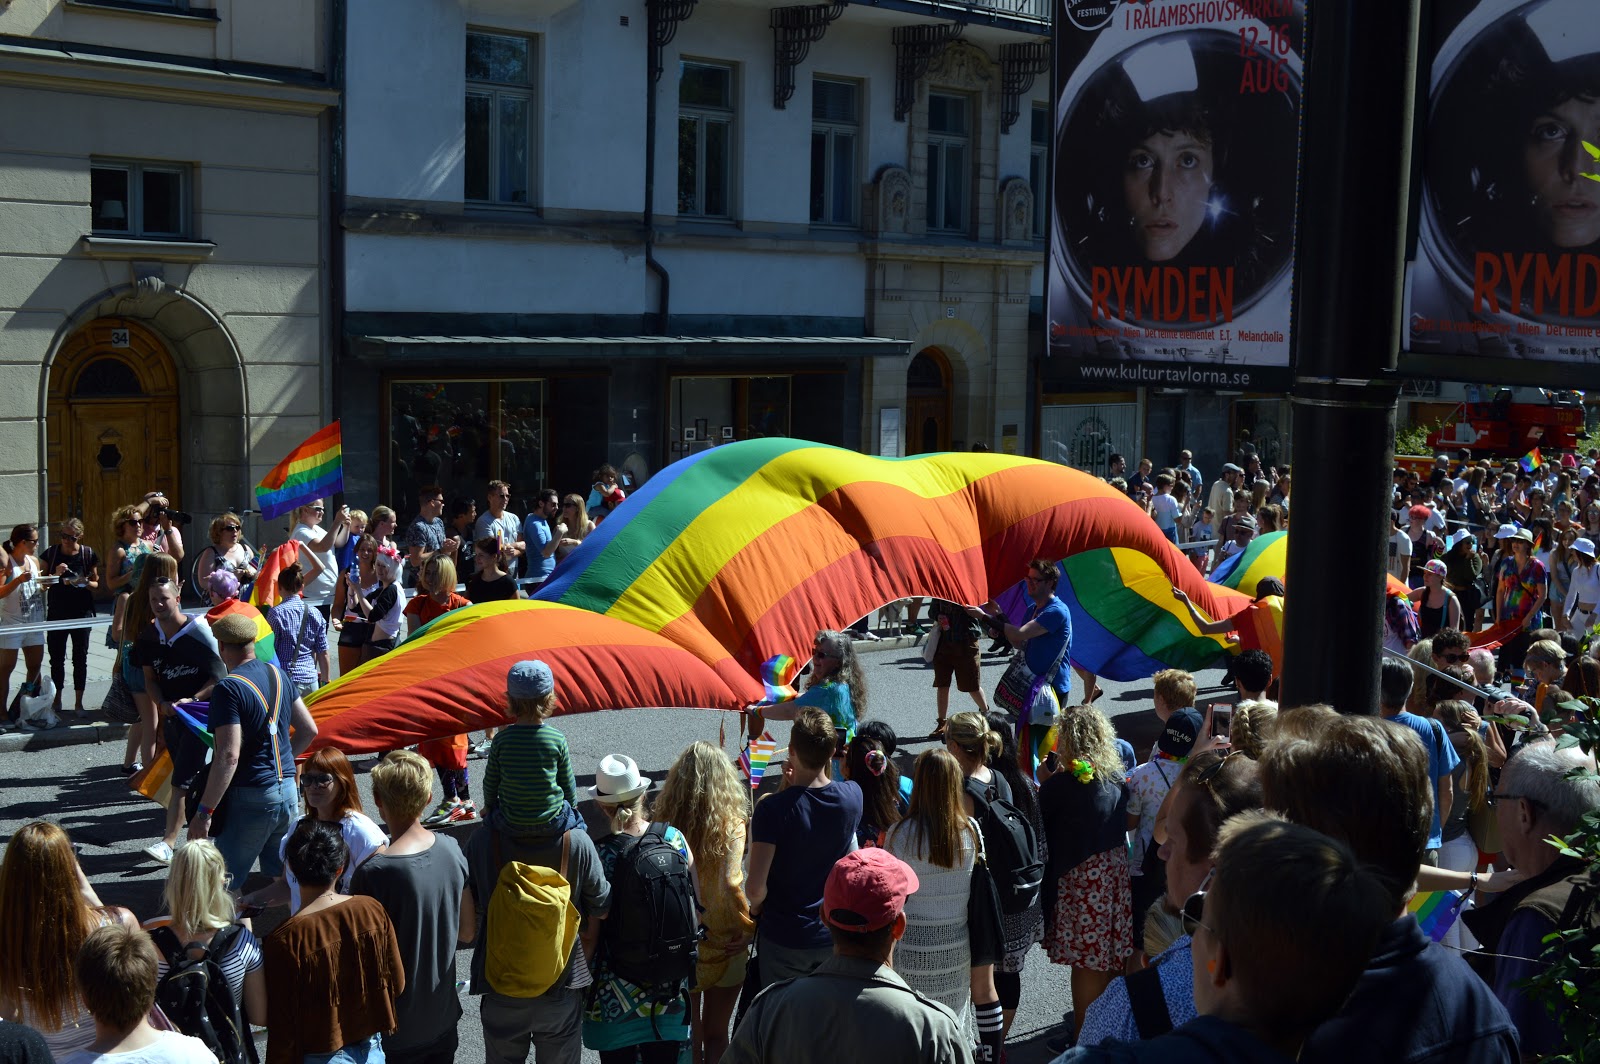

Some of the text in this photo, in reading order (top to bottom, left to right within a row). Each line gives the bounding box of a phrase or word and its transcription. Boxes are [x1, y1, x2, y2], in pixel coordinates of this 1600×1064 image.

[1077, 6, 1107, 18] FESTIVAL
[1126, 0, 1293, 30] I RÅLAMBSHOVSPARKEN
[1239, 24, 1291, 59] 12-16
[1239, 58, 1290, 94] AUG
[1091, 265, 1234, 322] RYMDEN
[112, 332, 128, 344] 34
[1145, 327, 1157, 339] Det
[1180, 329, 1215, 341] elementet
[1220, 330, 1232, 341] E.T.
[1238, 330, 1284, 343] Melancholia
[1517, 322, 1540, 335] Alien
[1547, 323, 1562, 337] Det
[1566, 325, 1593, 338] femte
[1080, 363, 1250, 385] www.kulturtavlorna.se
